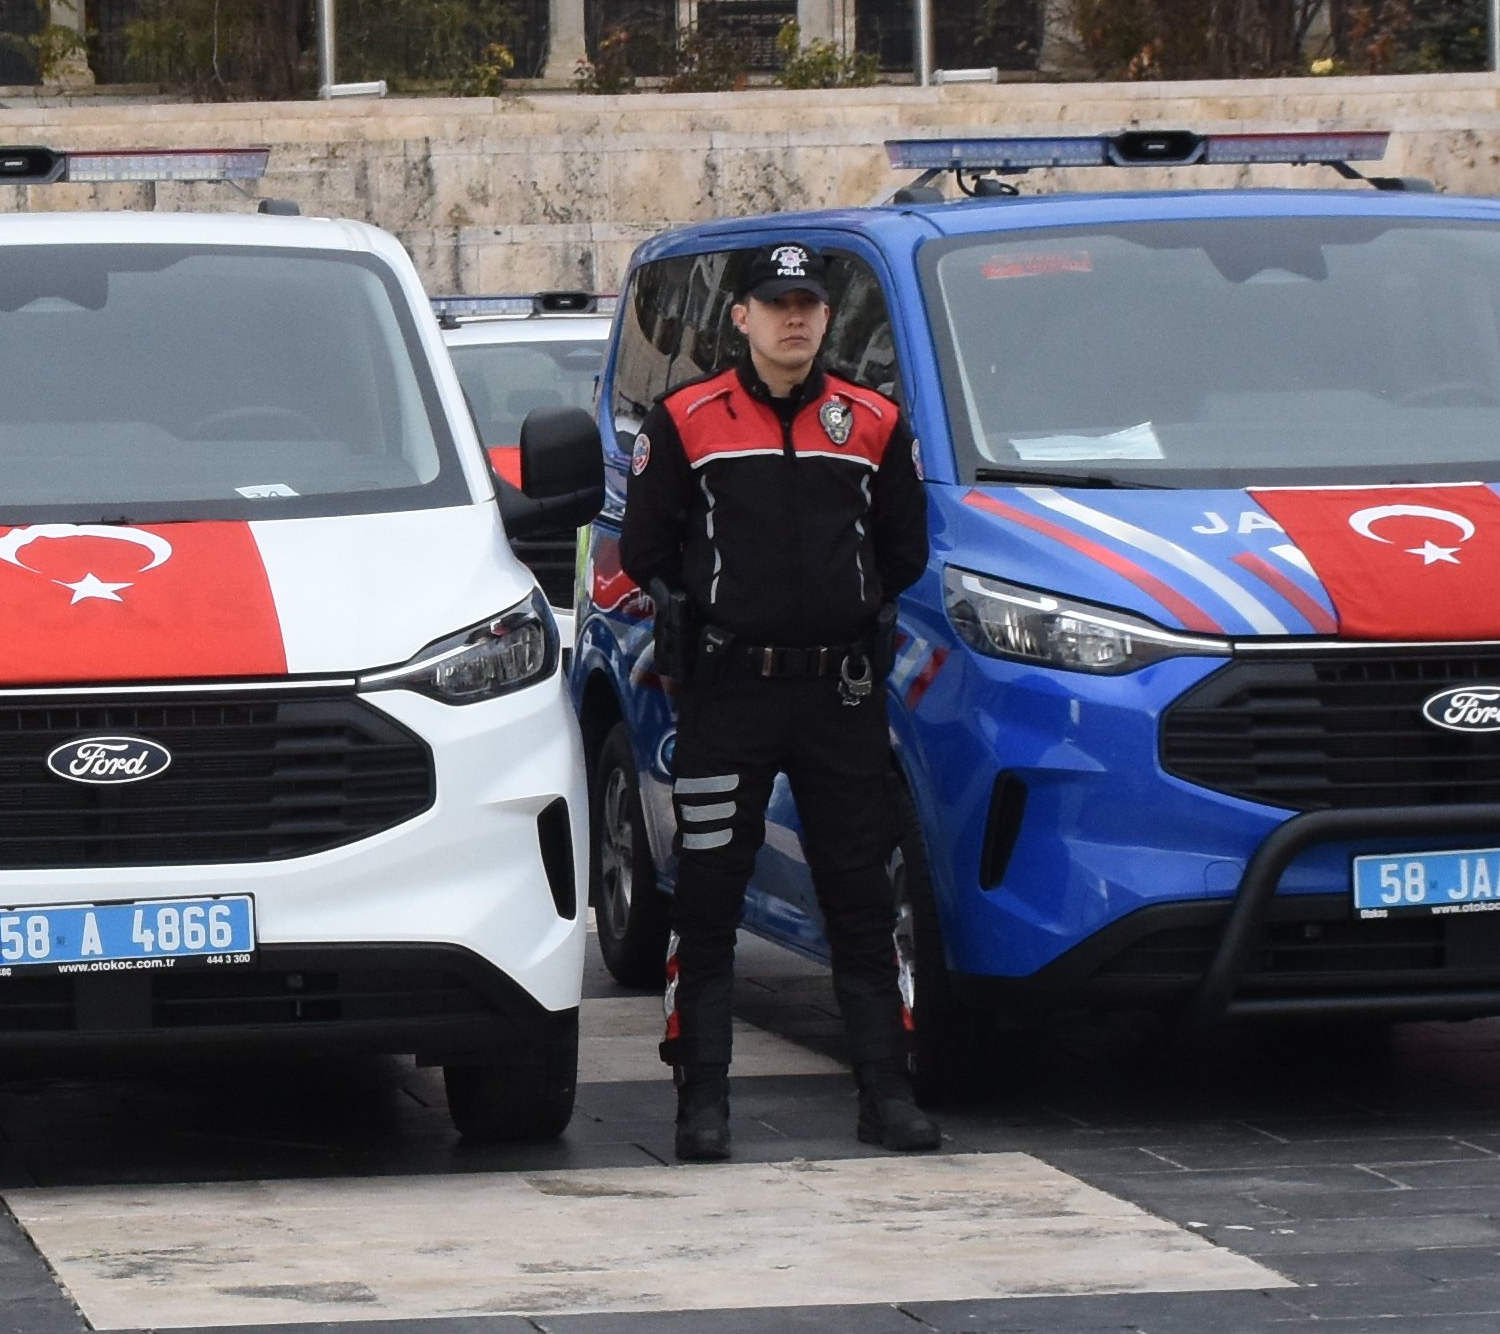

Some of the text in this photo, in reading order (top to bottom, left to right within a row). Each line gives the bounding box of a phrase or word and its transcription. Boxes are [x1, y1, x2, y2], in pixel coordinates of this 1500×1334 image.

[69, 743, 149, 776] Ford
[1380, 862, 1426, 904] 58
[0, 904, 232, 960] 58 A 4866
[57, 957, 176, 973] www.otokoc.com.tr
[206, 955, 223, 964] 444
[225, 954, 232, 964] 3
[233, 953, 251, 964] 300
